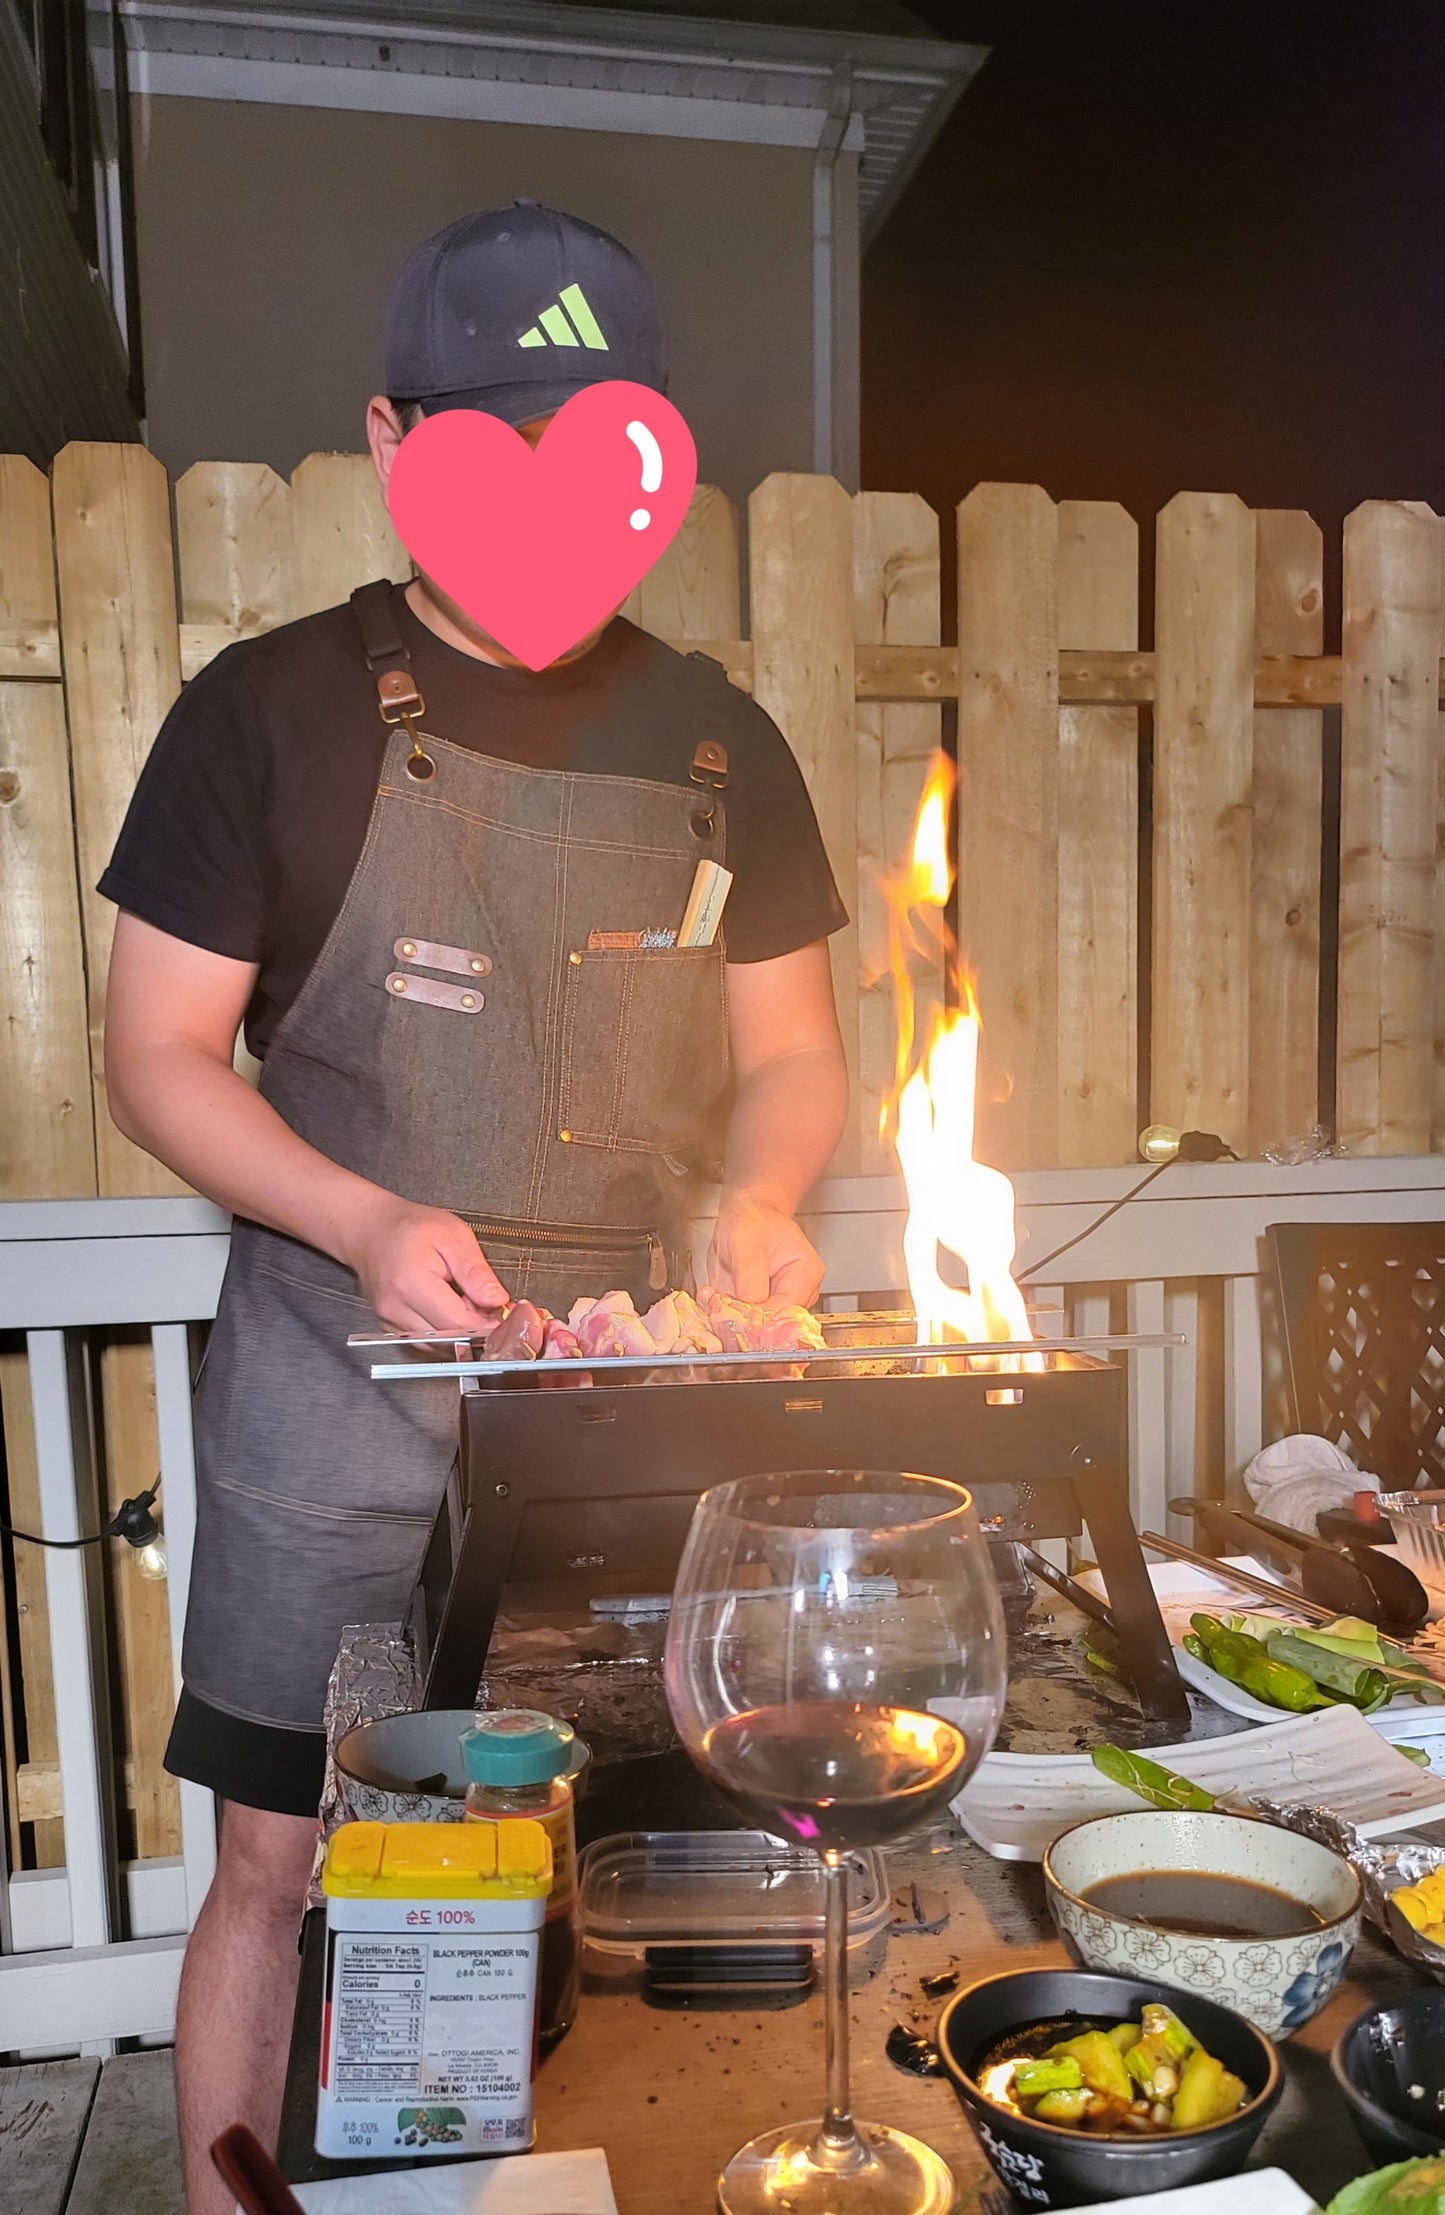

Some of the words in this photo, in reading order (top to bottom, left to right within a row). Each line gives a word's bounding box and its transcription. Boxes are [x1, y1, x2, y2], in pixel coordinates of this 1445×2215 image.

[406, 1910, 432, 1924] 순도
[437, 1910, 475, 1924] 100%
[352, 1946, 392, 1954] Nutrition
[395, 1946, 419, 1954] Facts
[433, 1950, 456, 1958] BLACK
[457, 1950, 484, 1958] PEPPER
[515, 1949, 529, 1958] 100g
[473, 1959, 490, 1968] (CAN)
[343, 1980, 379, 1988] Calories
[414, 1980, 421, 1988] 0
[425, 2085, 448, 2094] ITEM
[452, 2085, 467, 2093] NO
[476, 2083, 521, 2092] 15104002
[360, 2122, 379, 2133] 100%
[349, 2135, 363, 2145] 100
[366, 2137, 372, 2146] g
